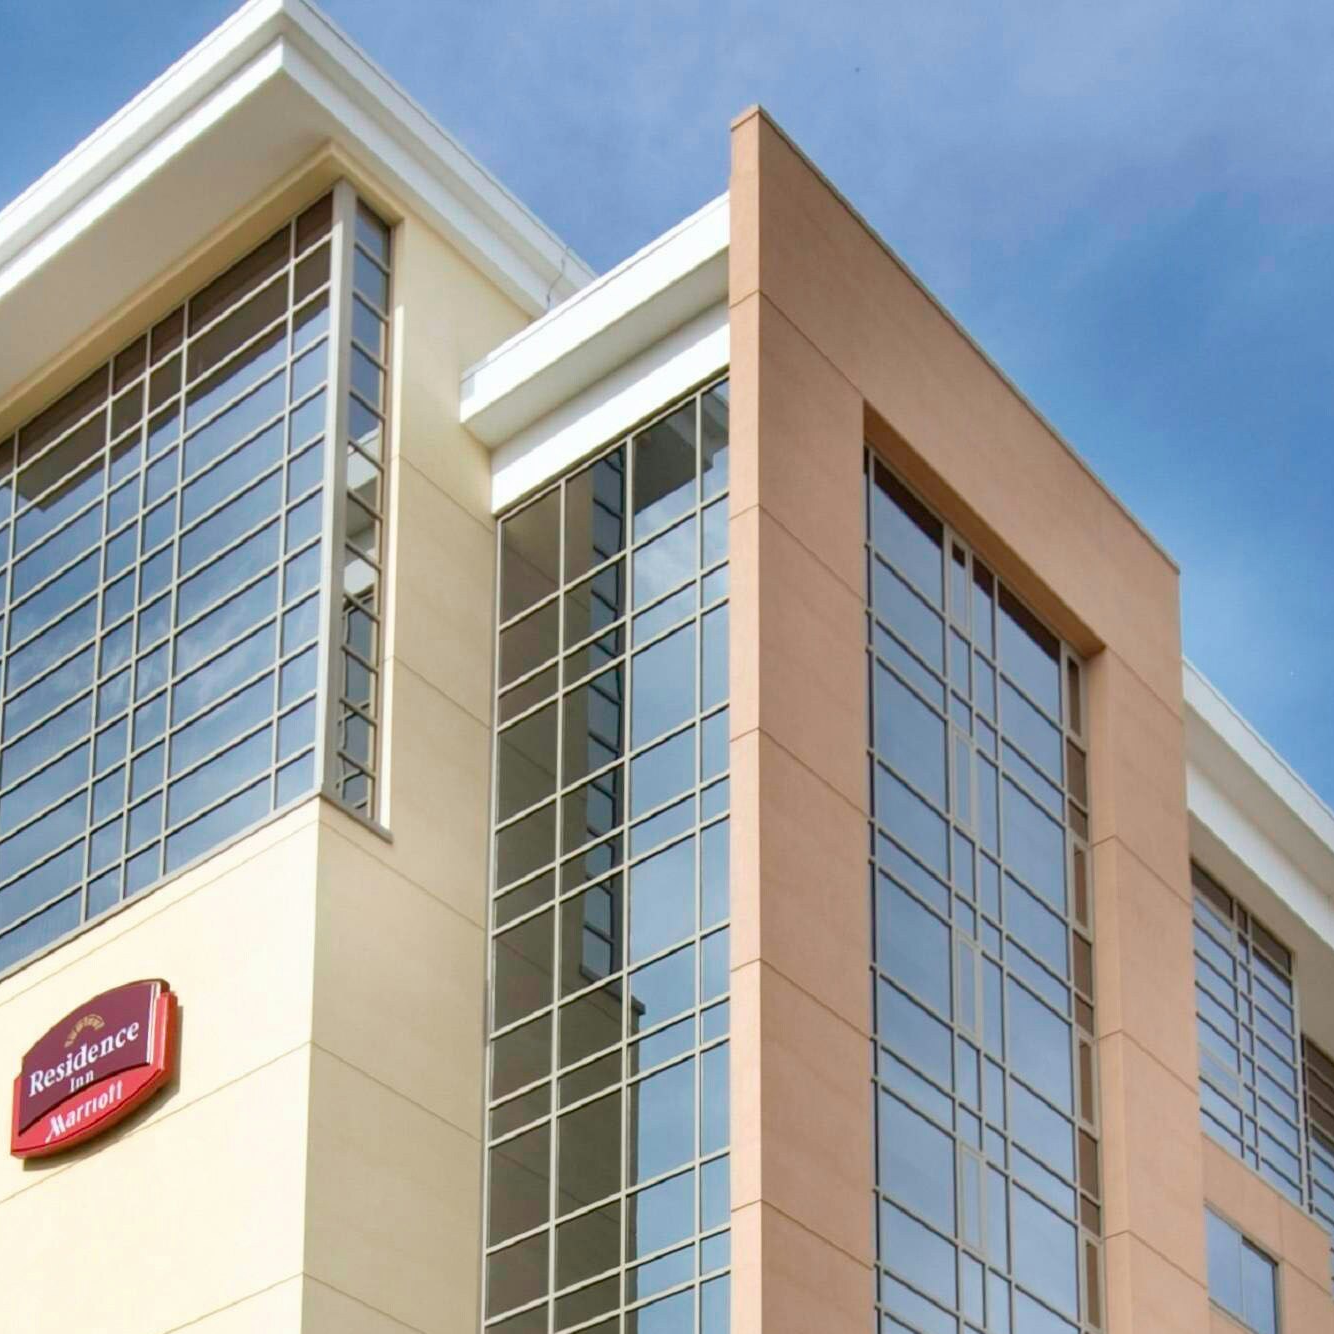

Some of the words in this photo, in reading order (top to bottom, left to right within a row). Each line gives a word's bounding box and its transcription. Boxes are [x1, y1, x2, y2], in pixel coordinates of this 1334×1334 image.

[29, 1021, 140, 1097] Residence
[69, 1070, 95, 1092] Inn
[45, 1081, 124, 1143] Marriott
